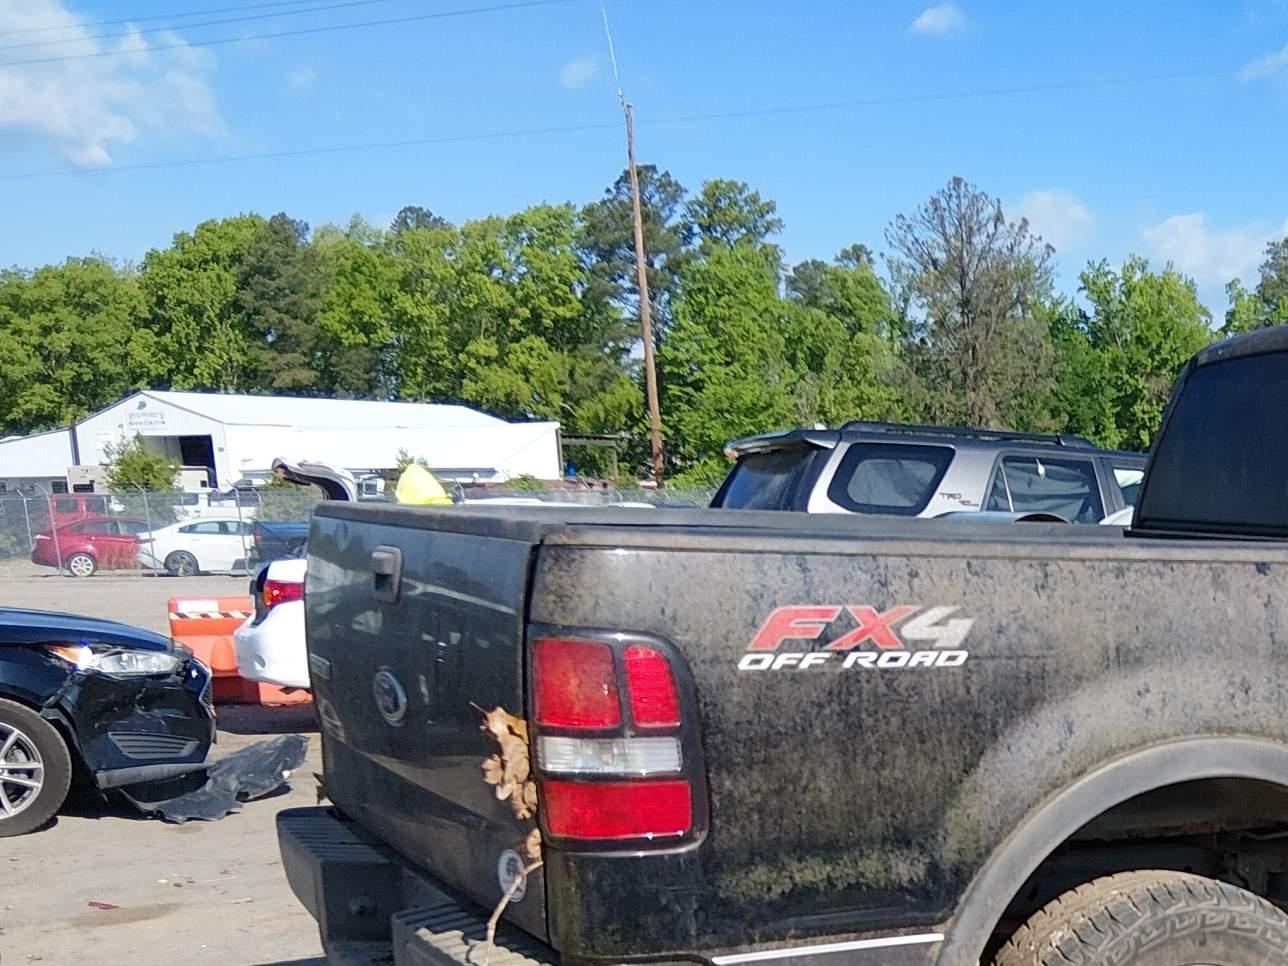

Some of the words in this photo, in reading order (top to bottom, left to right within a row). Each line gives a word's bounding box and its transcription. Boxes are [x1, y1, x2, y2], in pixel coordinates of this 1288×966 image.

[748, 604, 976, 651] FX4
[737, 652, 832, 671] OFF
[842, 650, 969, 670] ROAD
